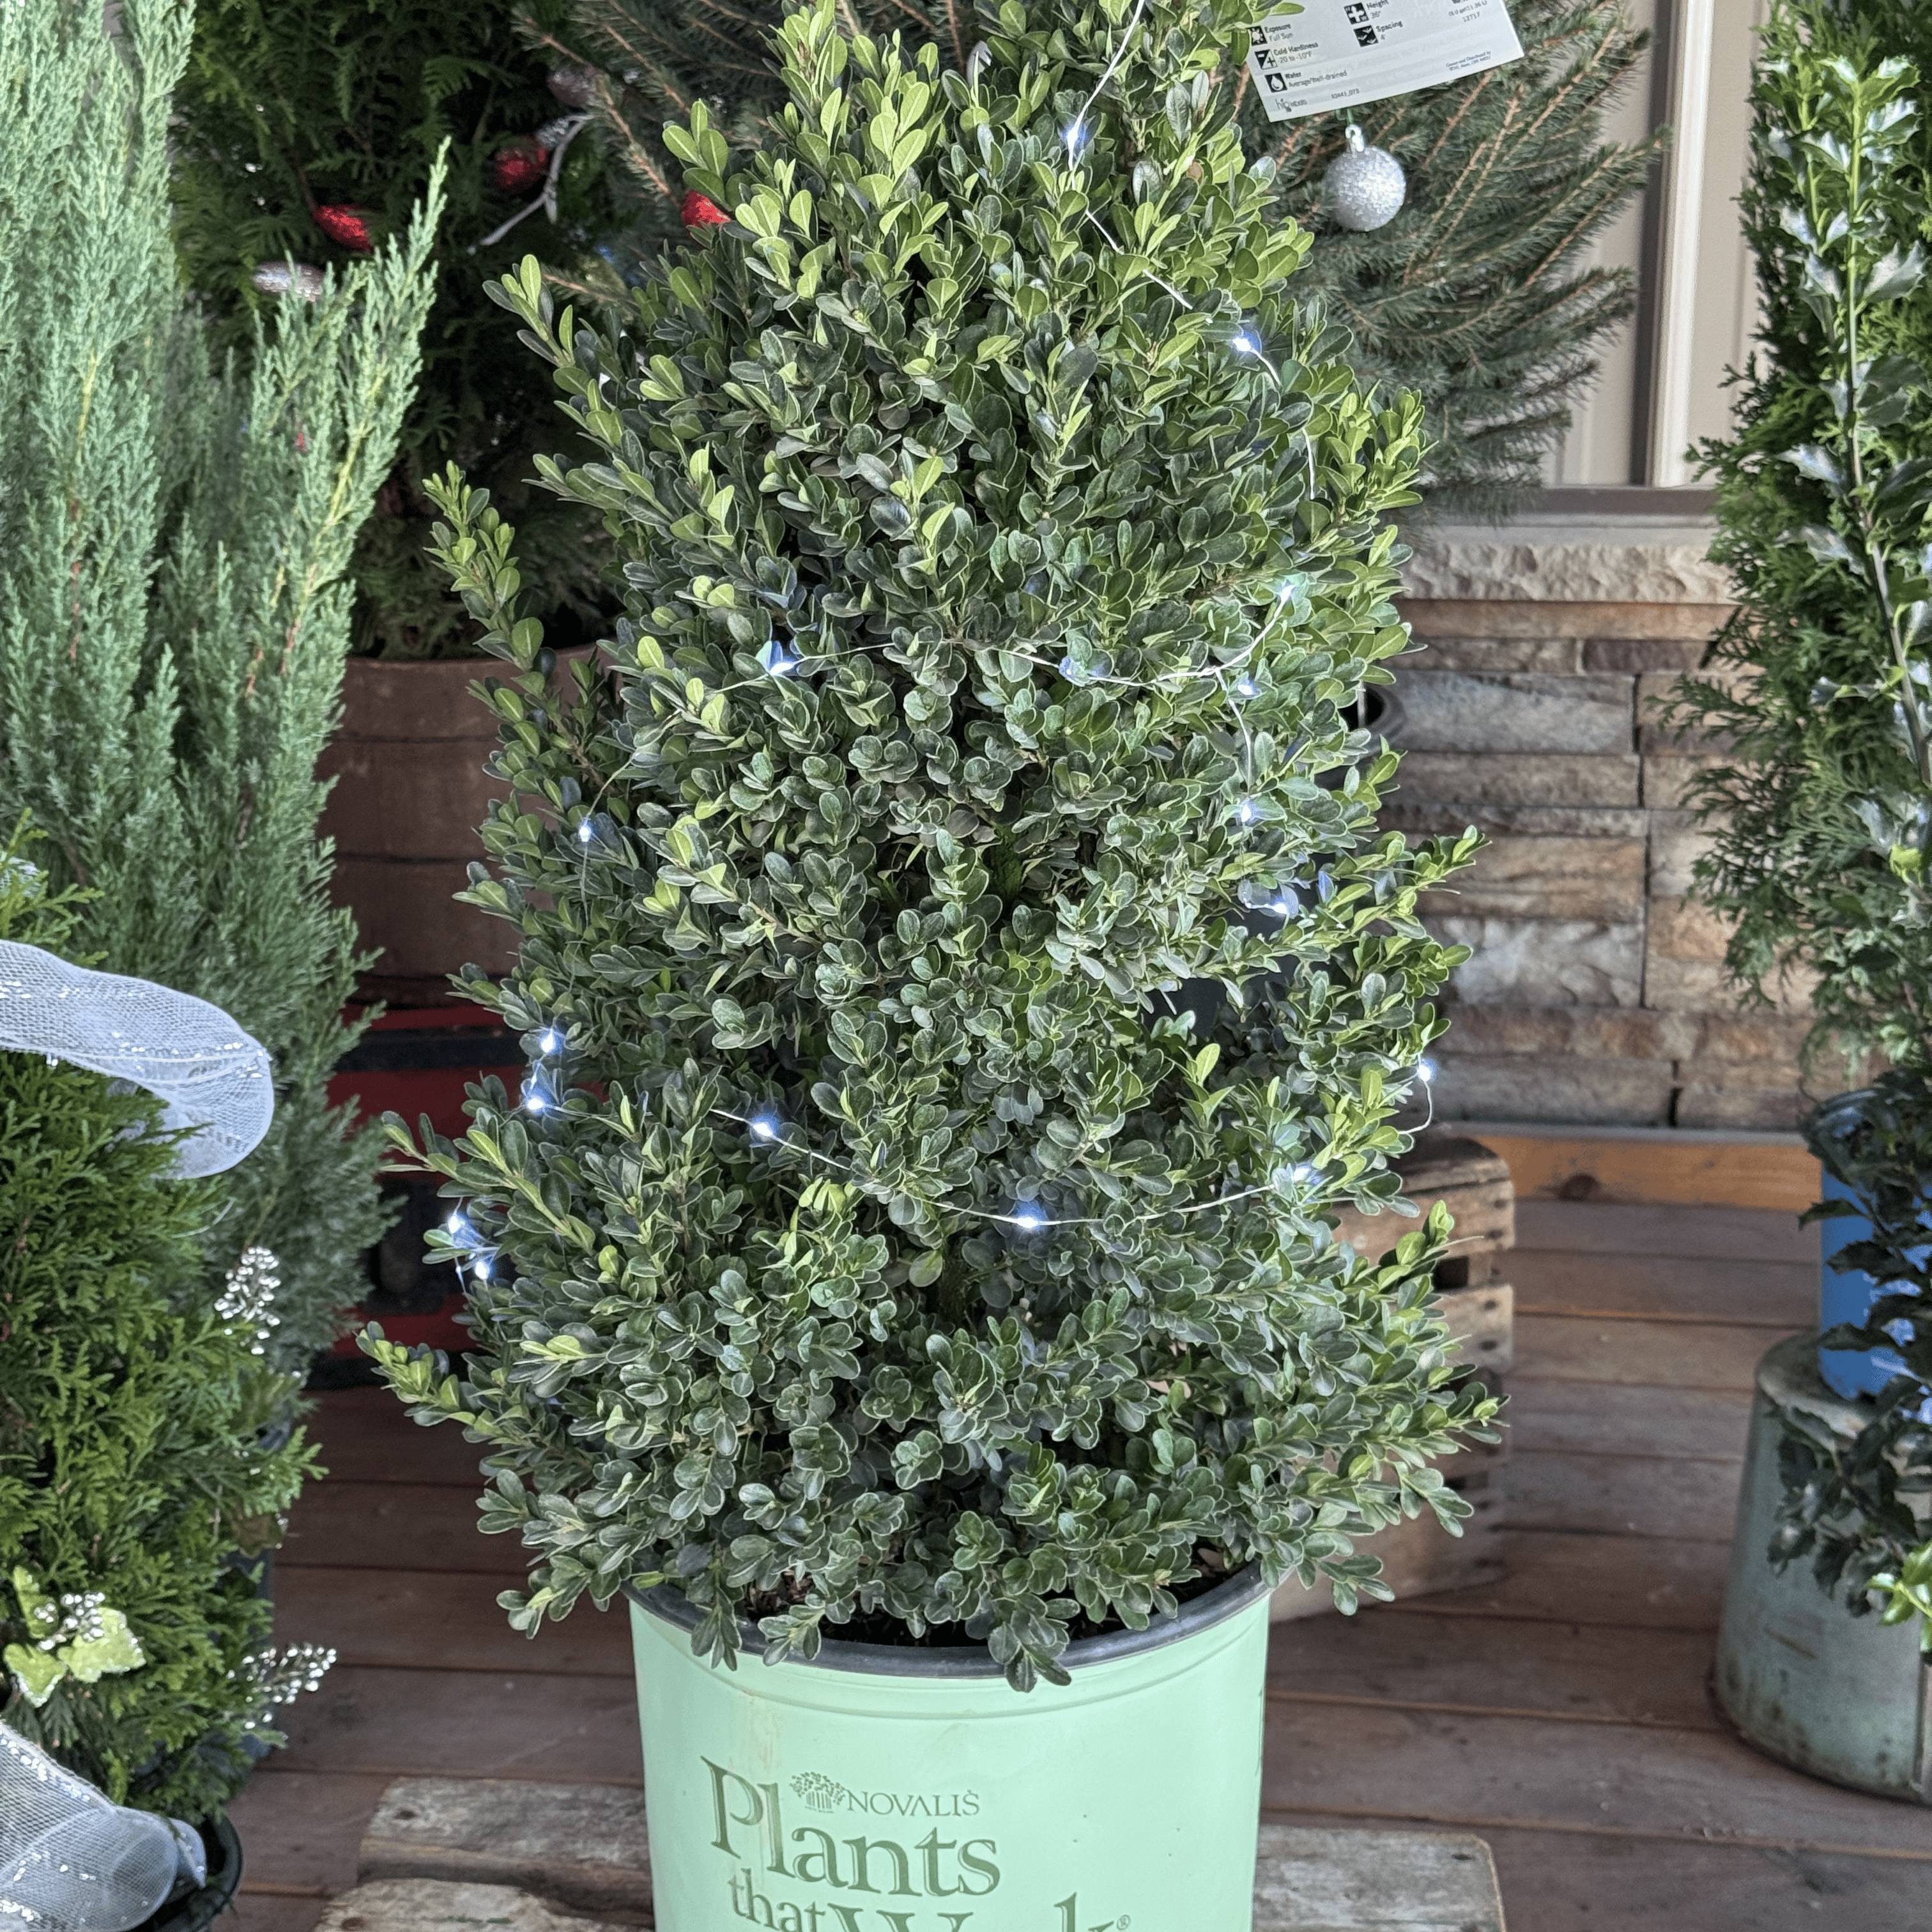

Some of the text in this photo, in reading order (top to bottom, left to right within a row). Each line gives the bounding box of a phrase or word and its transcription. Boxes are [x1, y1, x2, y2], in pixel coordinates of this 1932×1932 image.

[1366, 0, 1389, 10] Height
[1264, 24, 1291, 34] Exposure
[1376, 20, 1403, 32] Spacing
[1269, 33, 1280, 42] Full
[1273, 42, 1319, 56] Cold Hardiness
[845, 1788, 980, 1817] NOVALIS
[700, 1755, 1000, 1897] Plants
[728, 1868, 826, 1932] that
